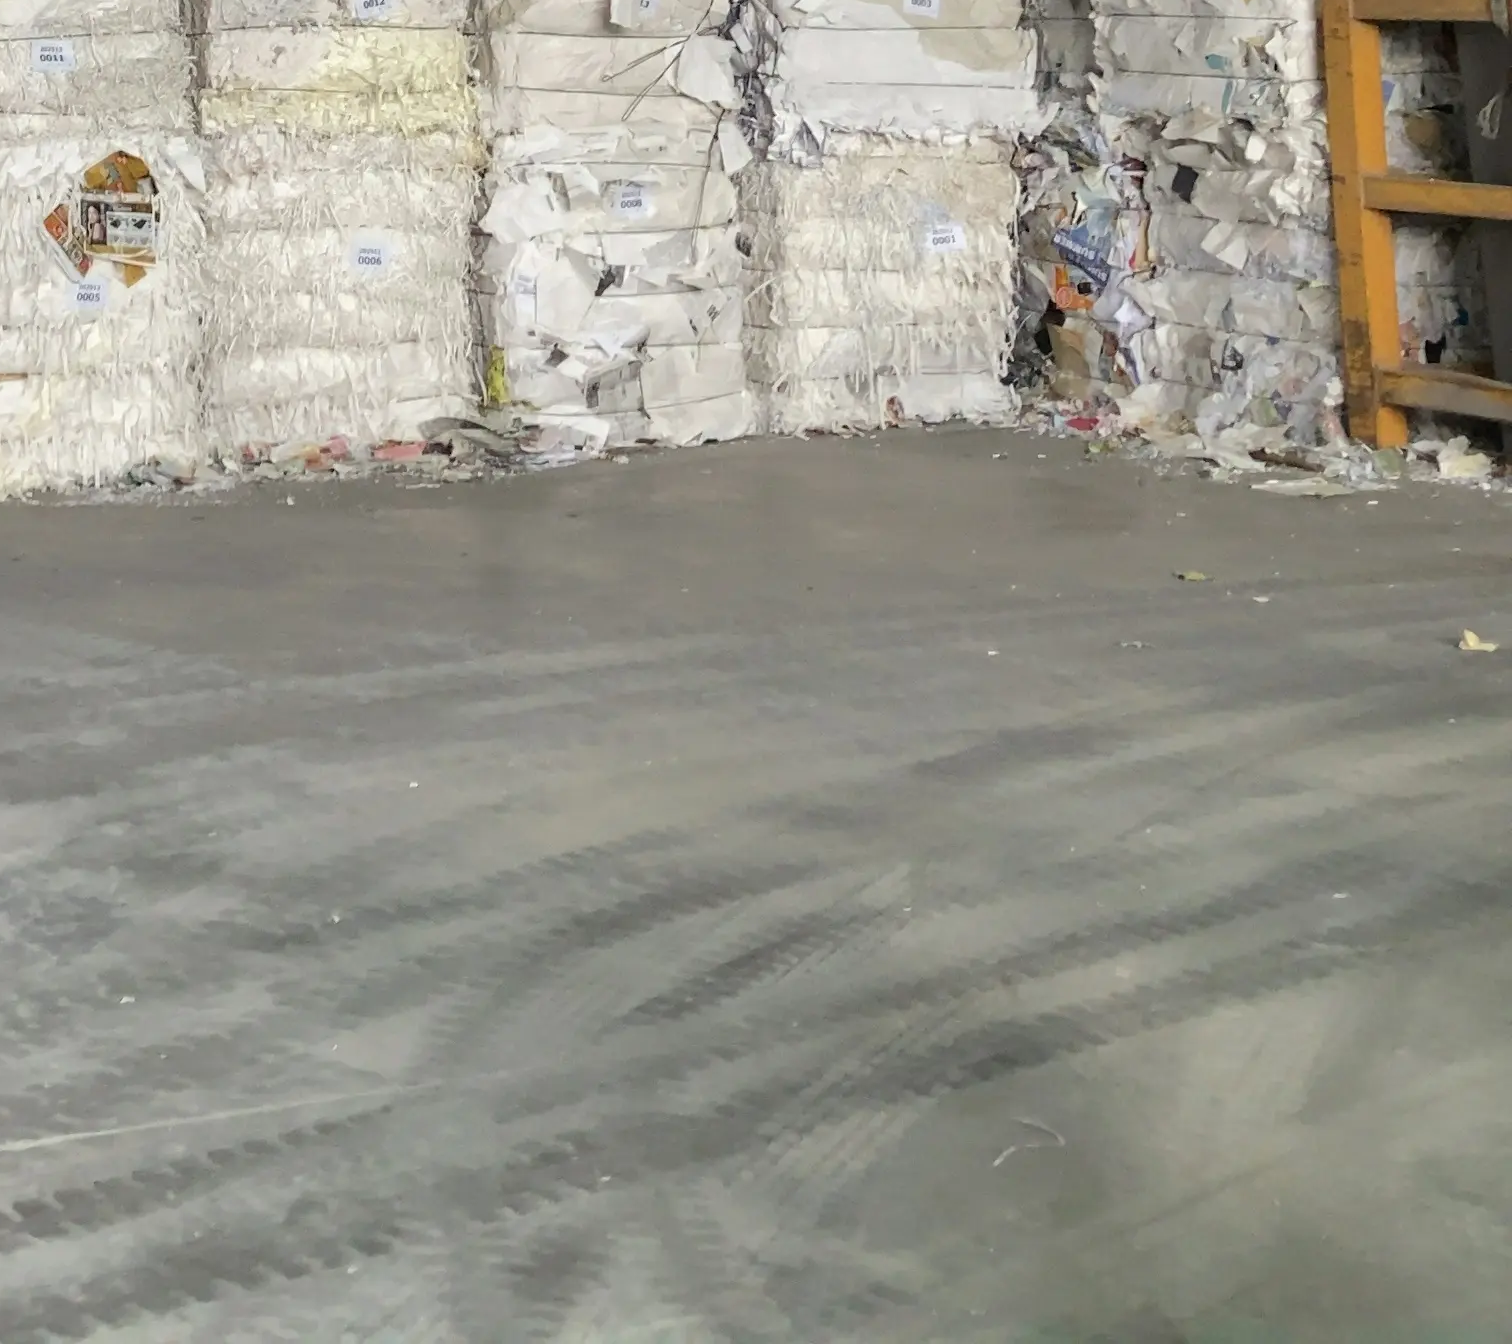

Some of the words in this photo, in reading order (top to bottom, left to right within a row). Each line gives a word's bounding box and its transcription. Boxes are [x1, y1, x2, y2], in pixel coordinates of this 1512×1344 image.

[39, 54, 65, 62] 0011
[932, 234, 956, 245] 0001
[357, 255, 382, 265] 0006
[76, 292, 100, 302] 0005
